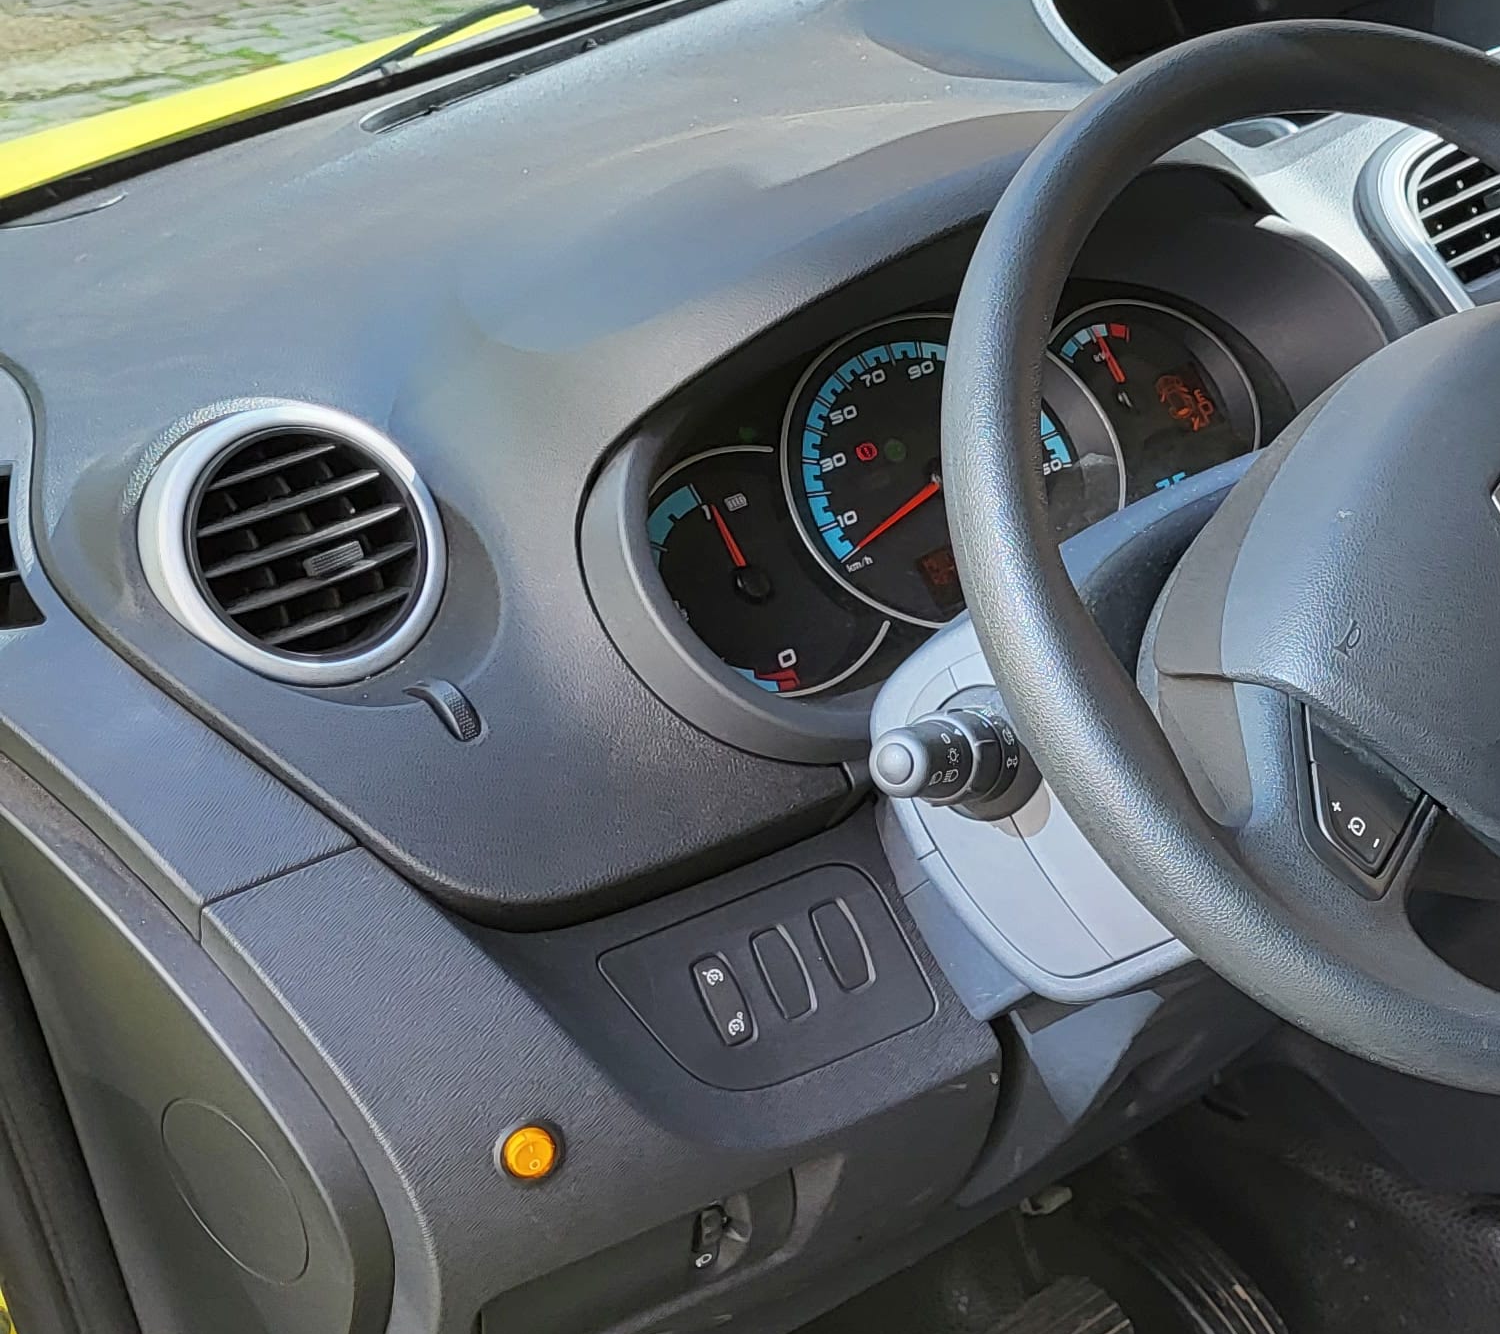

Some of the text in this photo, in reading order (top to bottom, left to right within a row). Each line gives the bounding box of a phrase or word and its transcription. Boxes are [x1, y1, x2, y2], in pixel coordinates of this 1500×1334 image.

[860, 369, 886, 388] 70
[907, 359, 935, 380] 90
[829, 404, 858, 425] 50
[819, 452, 847, 473] 30
[836, 510, 858, 528] 10
[845, 555, 873, 573] km/h
